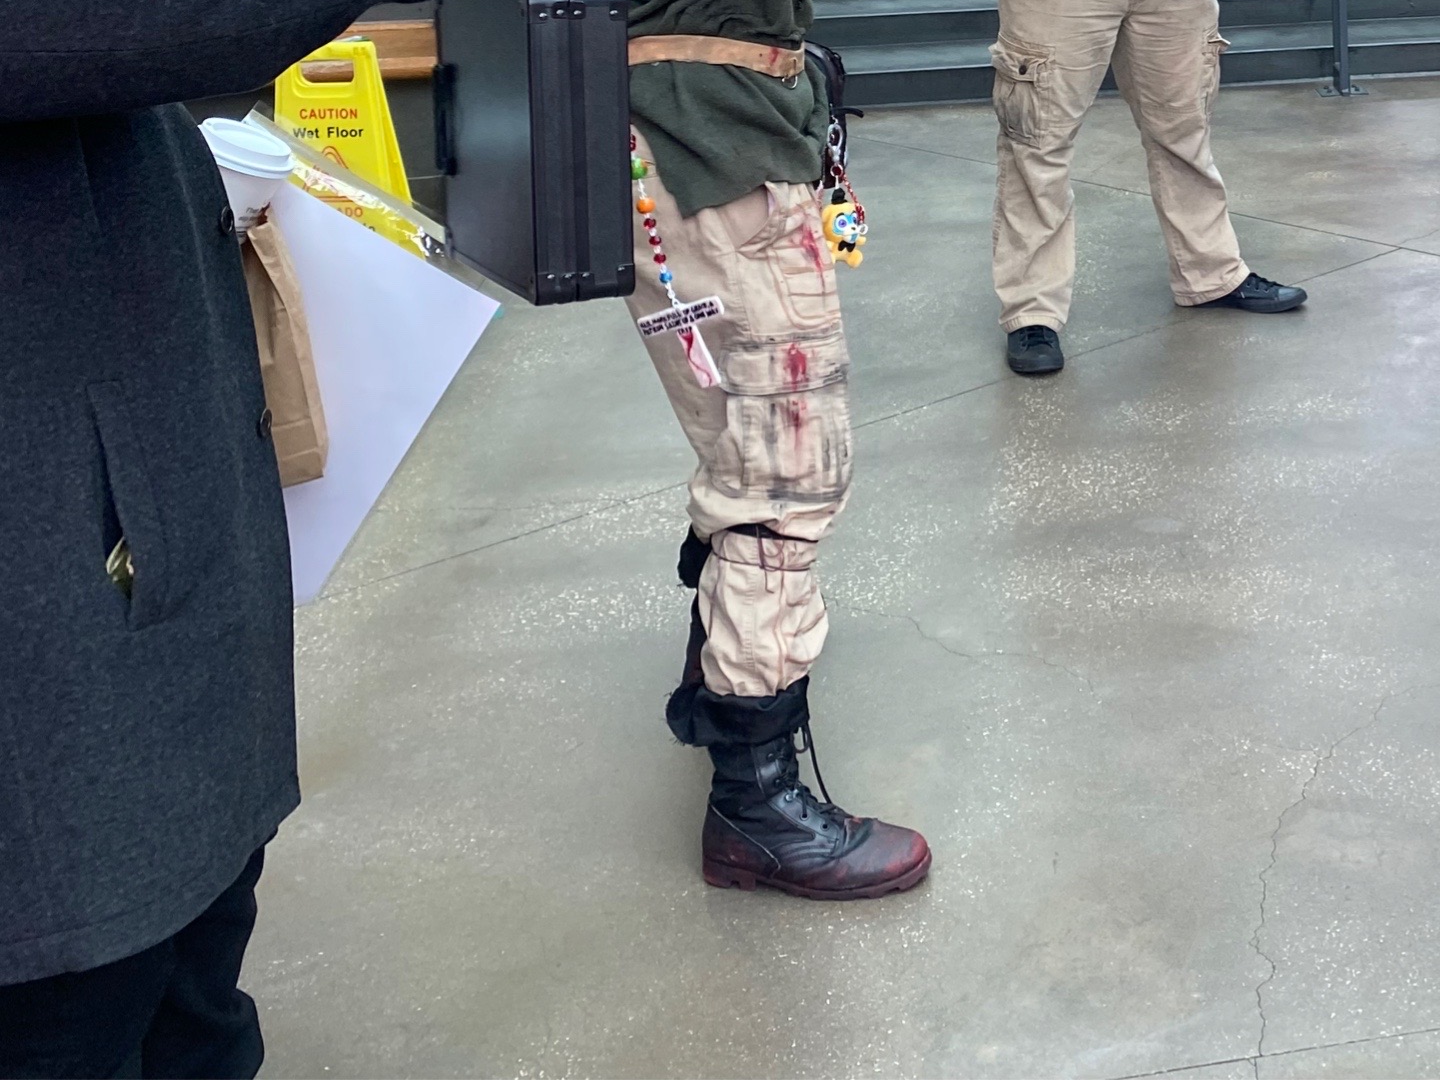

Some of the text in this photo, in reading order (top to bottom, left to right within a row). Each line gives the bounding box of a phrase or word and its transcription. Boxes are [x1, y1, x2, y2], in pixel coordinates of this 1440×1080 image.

[299, 108, 359, 120] CAUTION
[292, 126, 365, 139] Wet Floor
